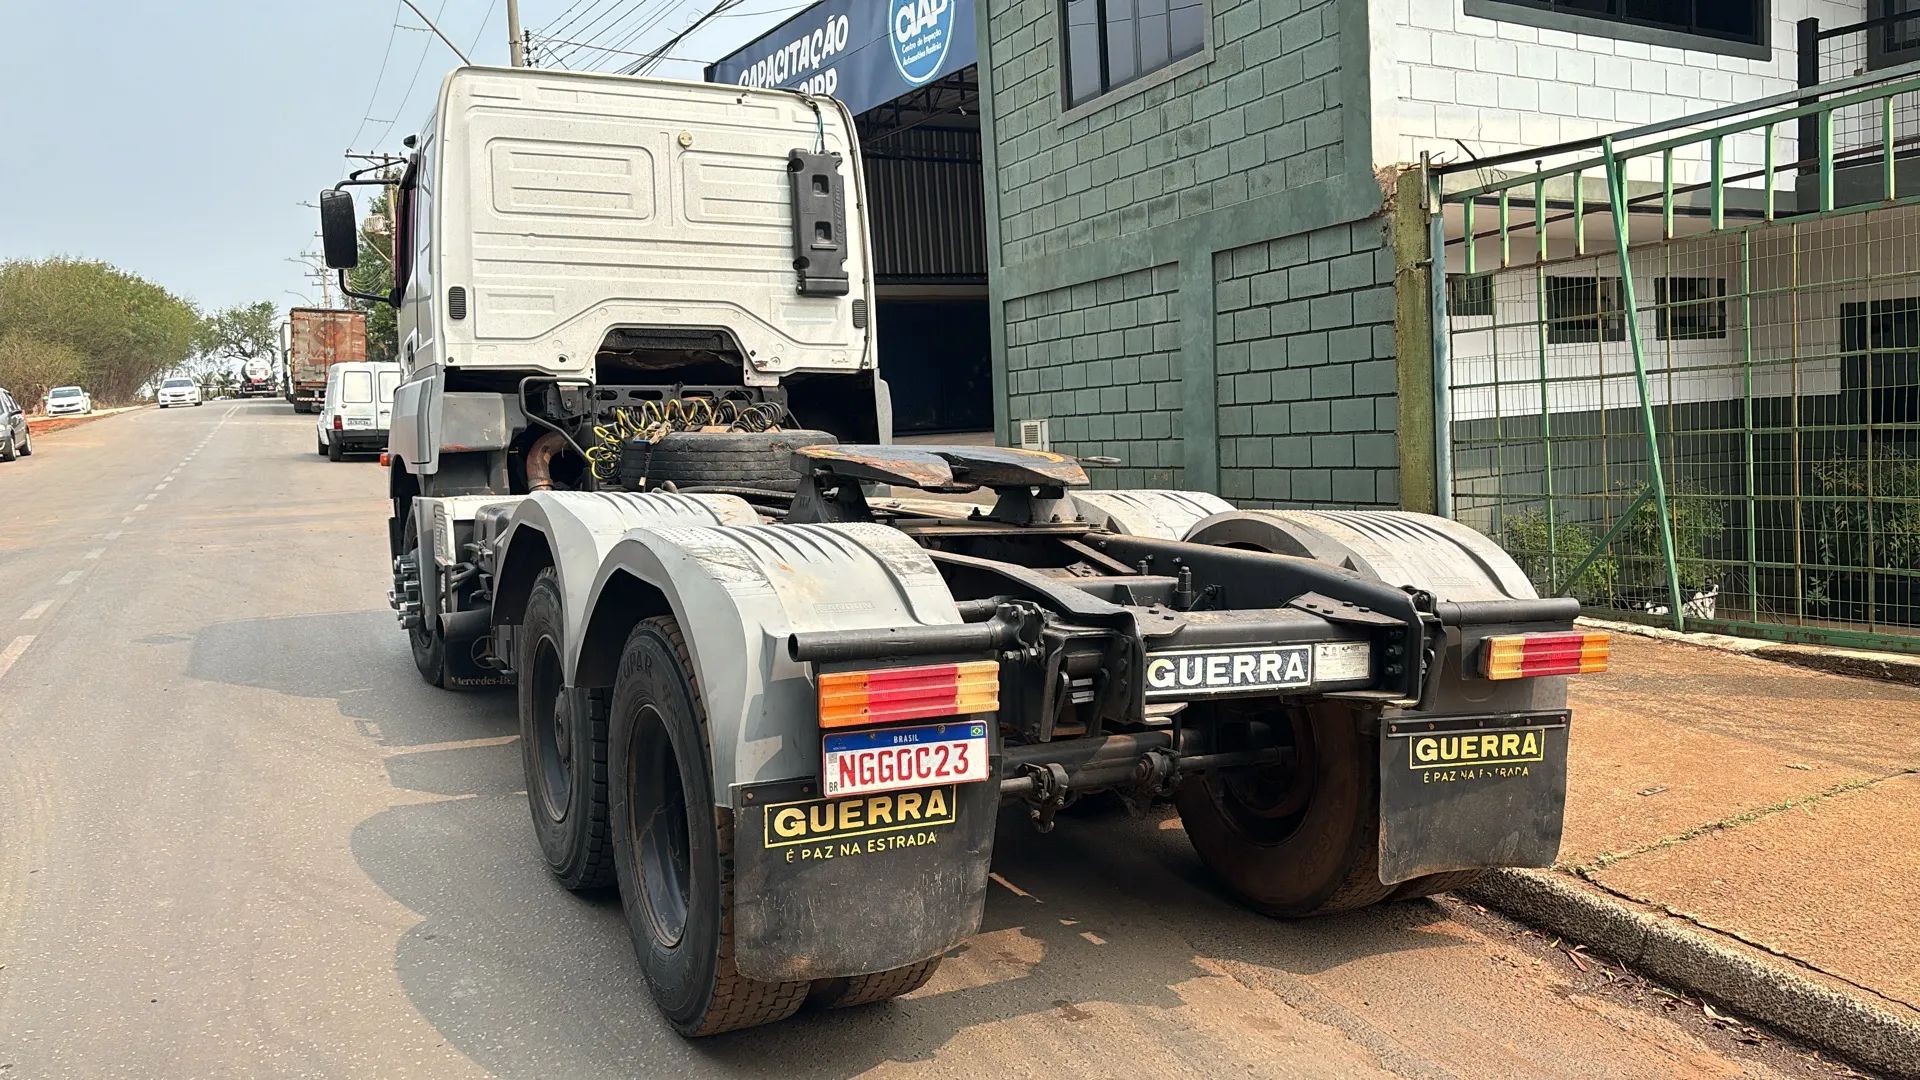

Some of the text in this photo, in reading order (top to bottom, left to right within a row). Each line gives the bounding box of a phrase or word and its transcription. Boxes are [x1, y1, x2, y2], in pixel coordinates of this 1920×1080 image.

[1147, 652, 1305, 688] GUERRA
[893, 734, 918, 743] BRASIL
[1416, 732, 1538, 761] GUERRA
[828, 781, 838, 792] BR
[1423, 771, 1430, 783] É
[1433, 771, 1456, 782] PAZ
[1460, 770, 1475, 780] NA
[774, 789, 948, 838] GUERRA
[786, 831, 937, 863] É PAZ NA ESTRADA
